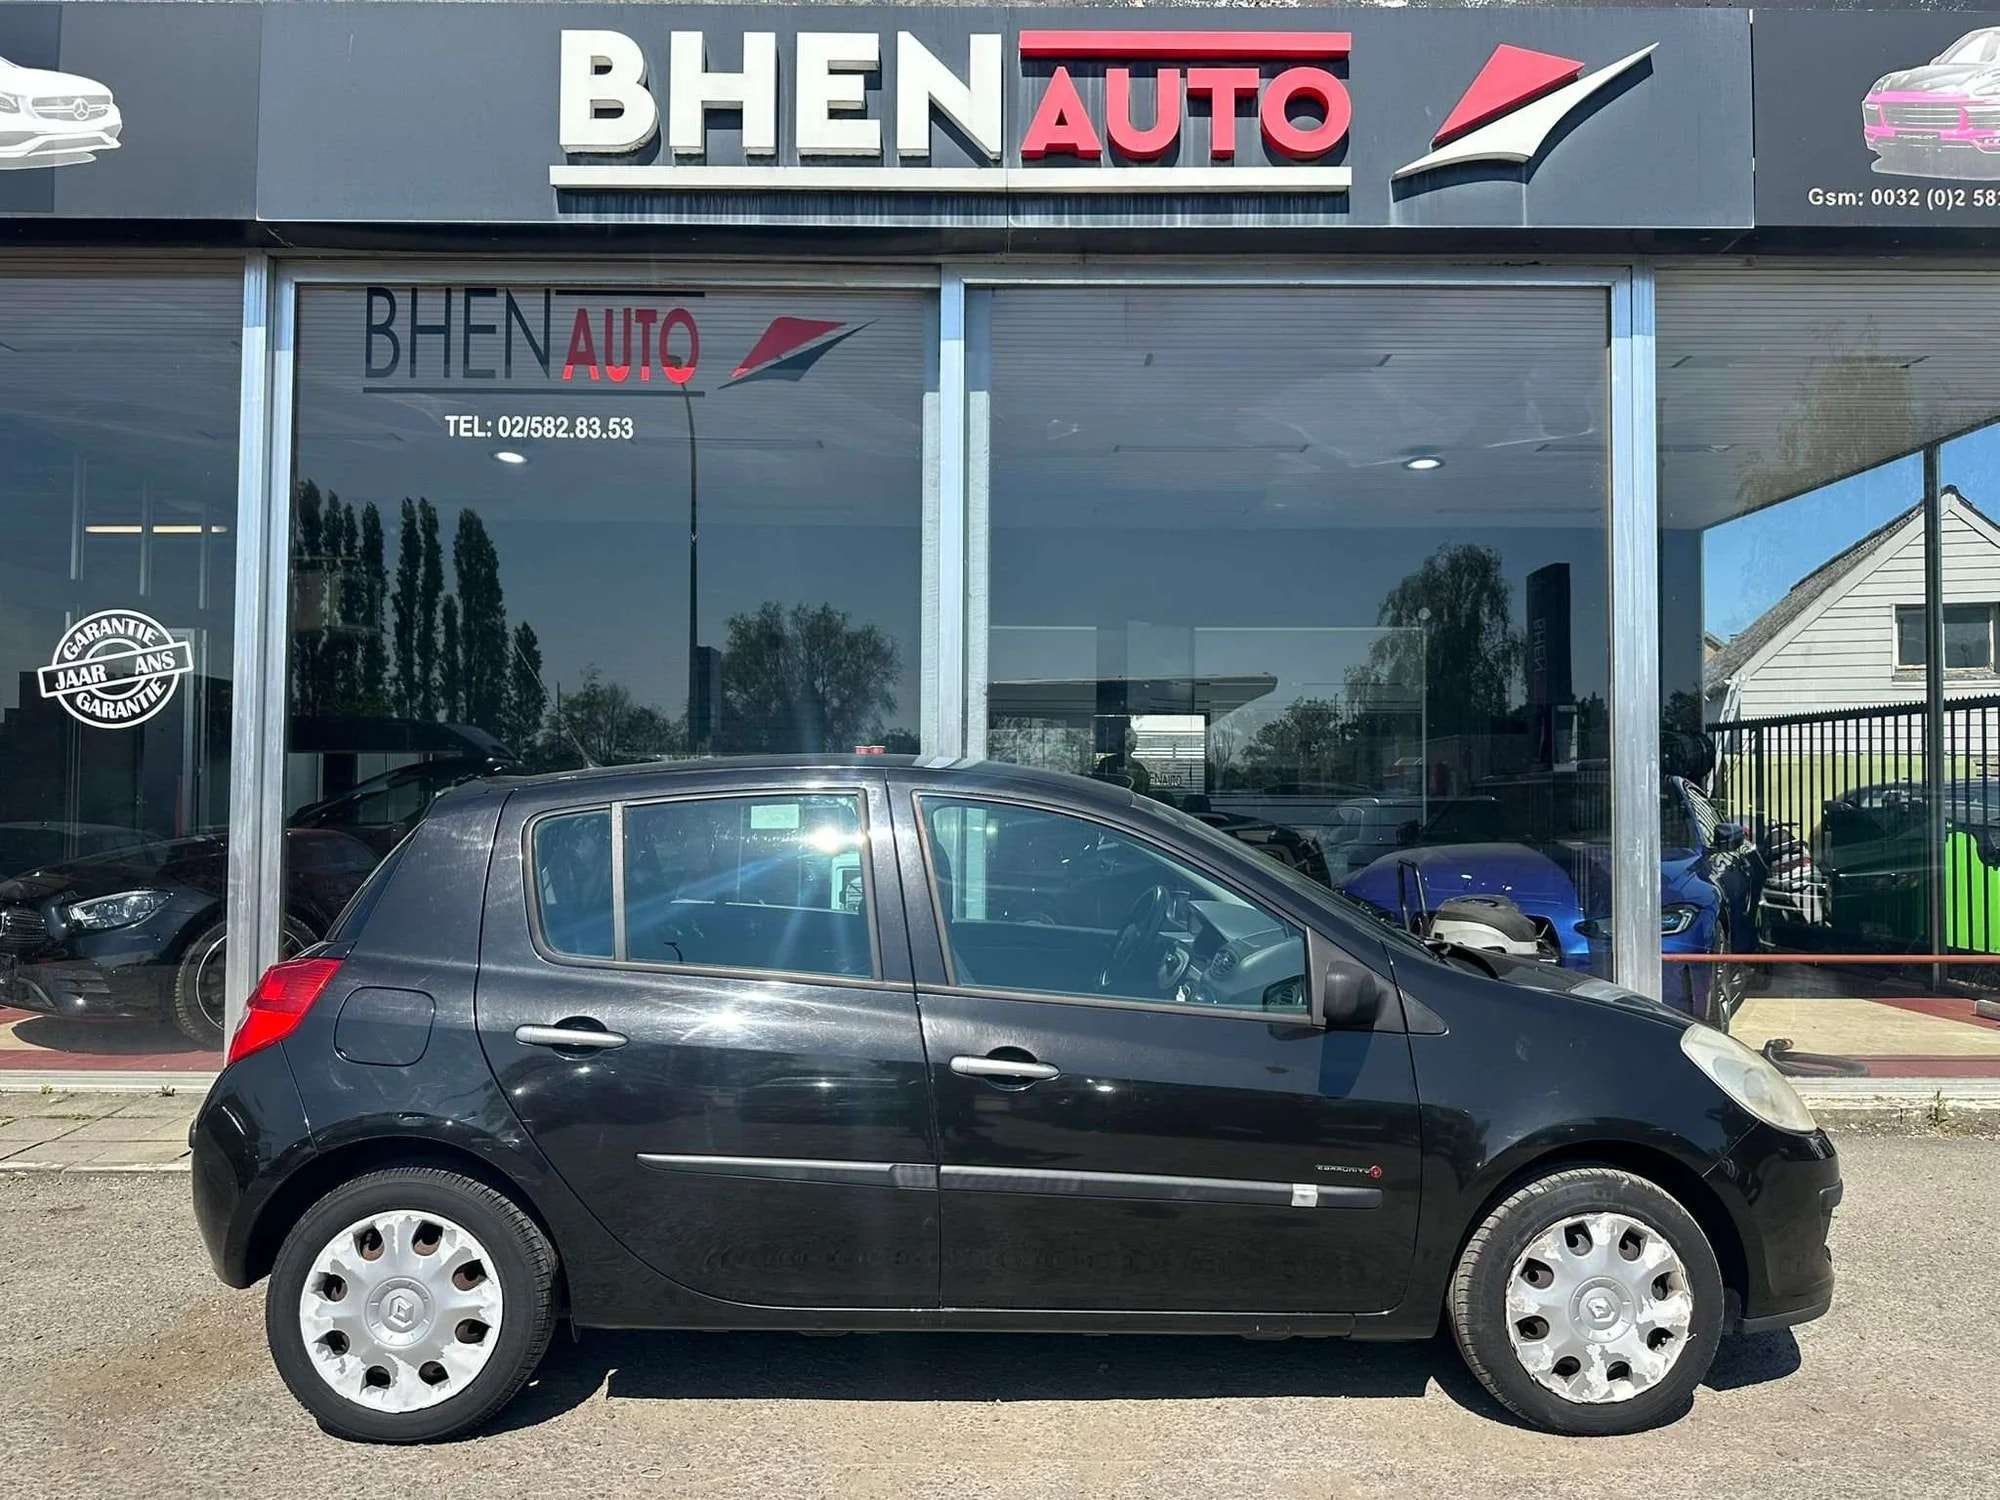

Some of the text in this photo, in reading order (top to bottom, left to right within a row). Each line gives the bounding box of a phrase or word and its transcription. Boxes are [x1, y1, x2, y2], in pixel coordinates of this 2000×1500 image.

[1808, 187, 2000, 210] Gsm: 0032 (0)2 58
[445, 415, 634, 440] TEL: 02/582.83.53
[63, 618, 160, 661] GARANTIE
[55, 651, 176, 690] JAAR ANS
[76, 679, 167, 719] GARANTIE
